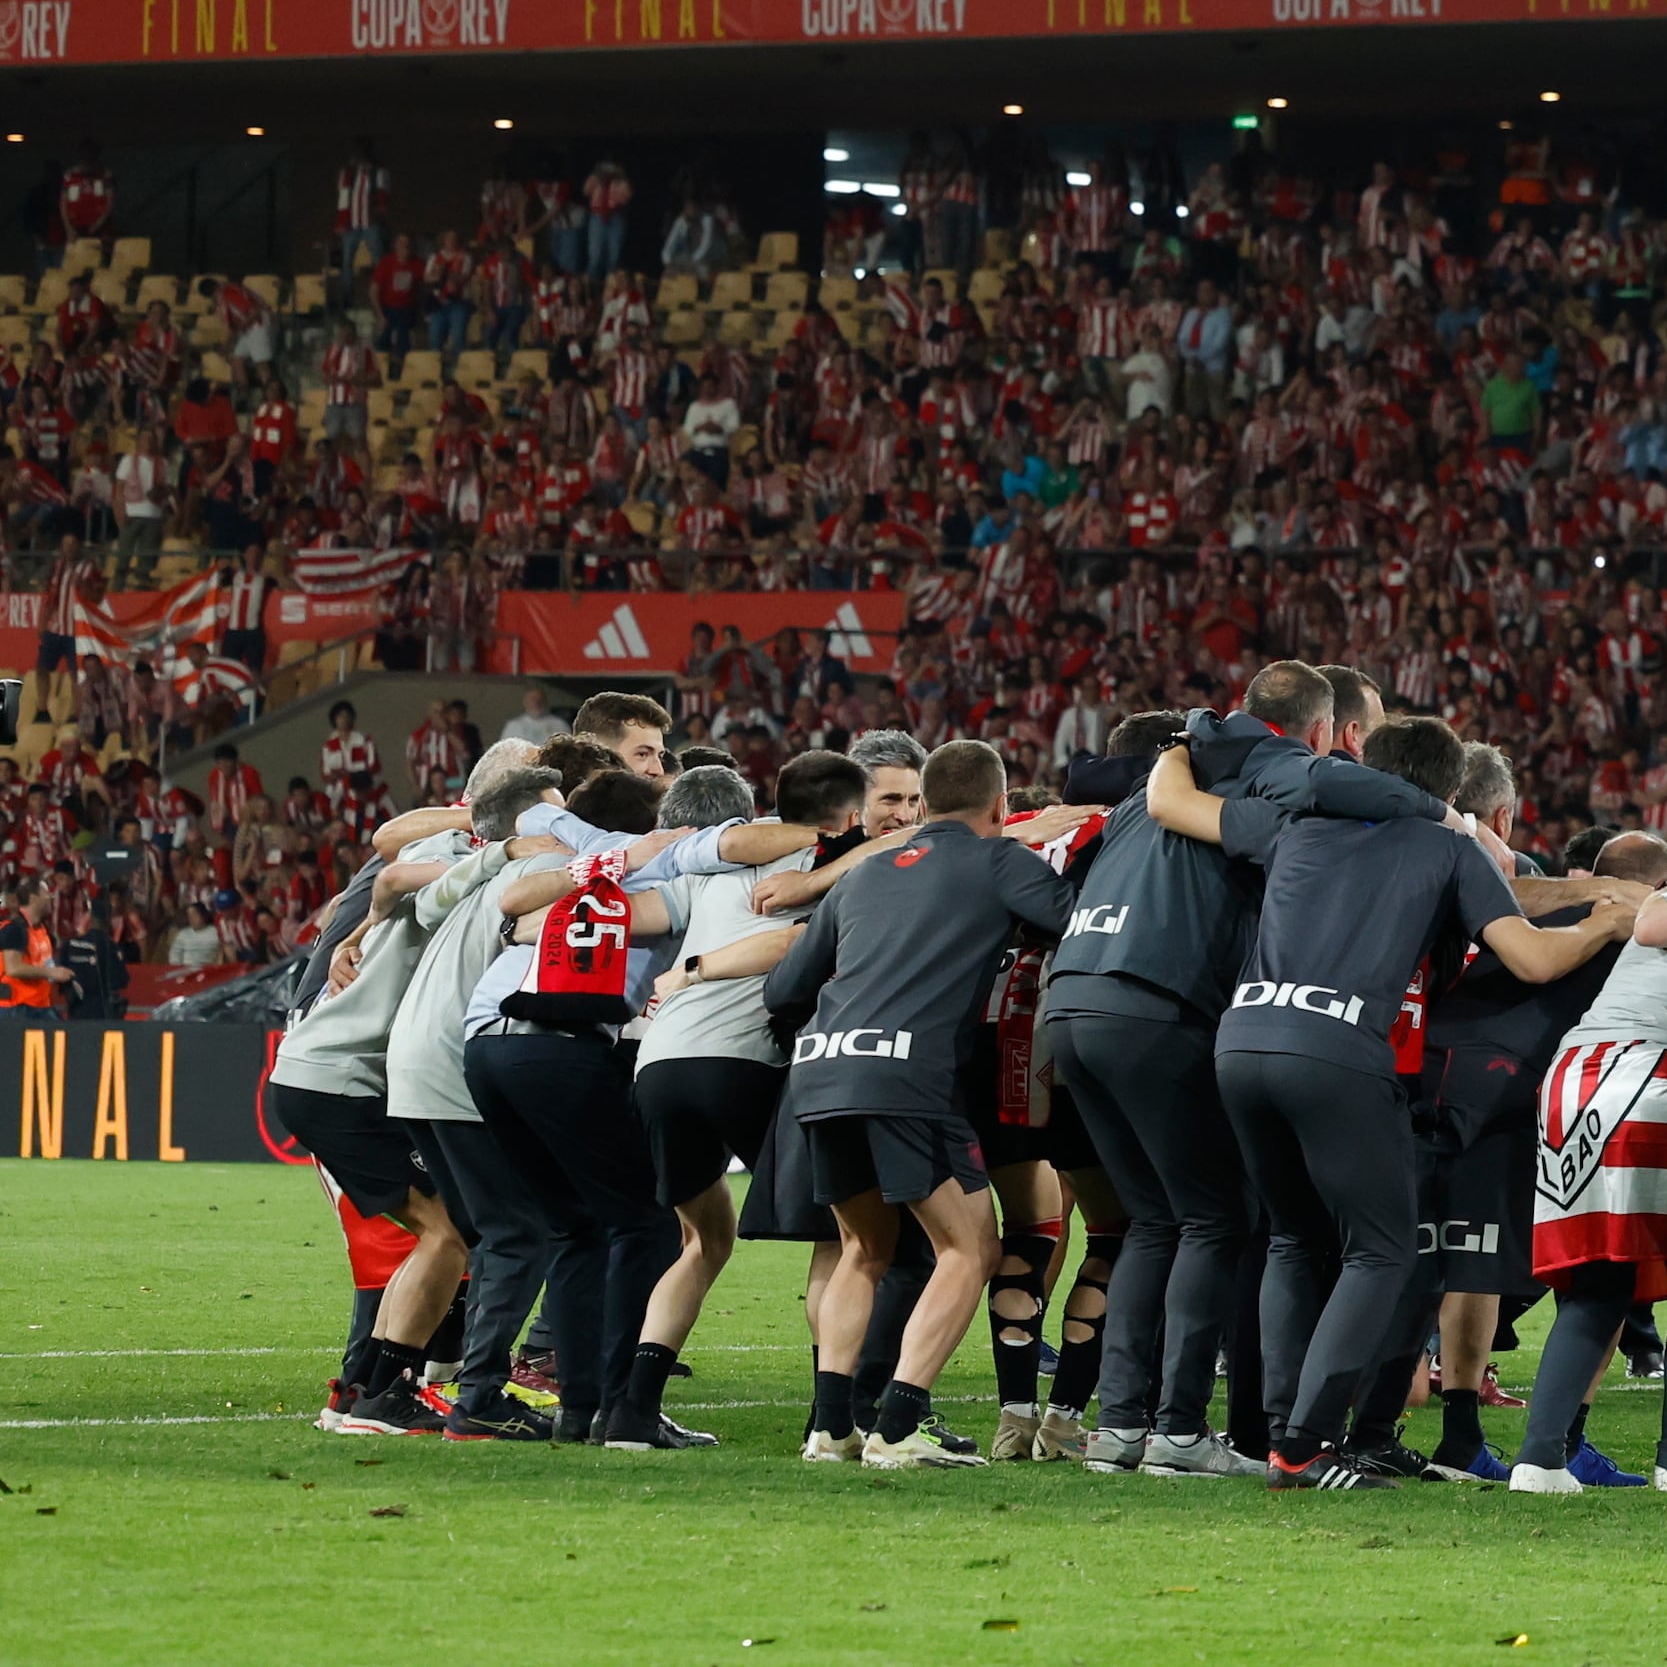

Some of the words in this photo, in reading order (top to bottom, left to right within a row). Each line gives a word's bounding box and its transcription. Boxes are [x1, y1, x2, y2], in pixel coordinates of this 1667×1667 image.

[21, 0, 72, 58] REY
[9, 595, 43, 628] REY
[564, 893, 627, 950] 25
[545, 933, 566, 968] 2024
[1232, 980, 1365, 1027] DIGI
[793, 1027, 913, 1067] DIGI
[20, 1029, 186, 1165] NAL
[1541, 1107, 1602, 1196] LBAO
